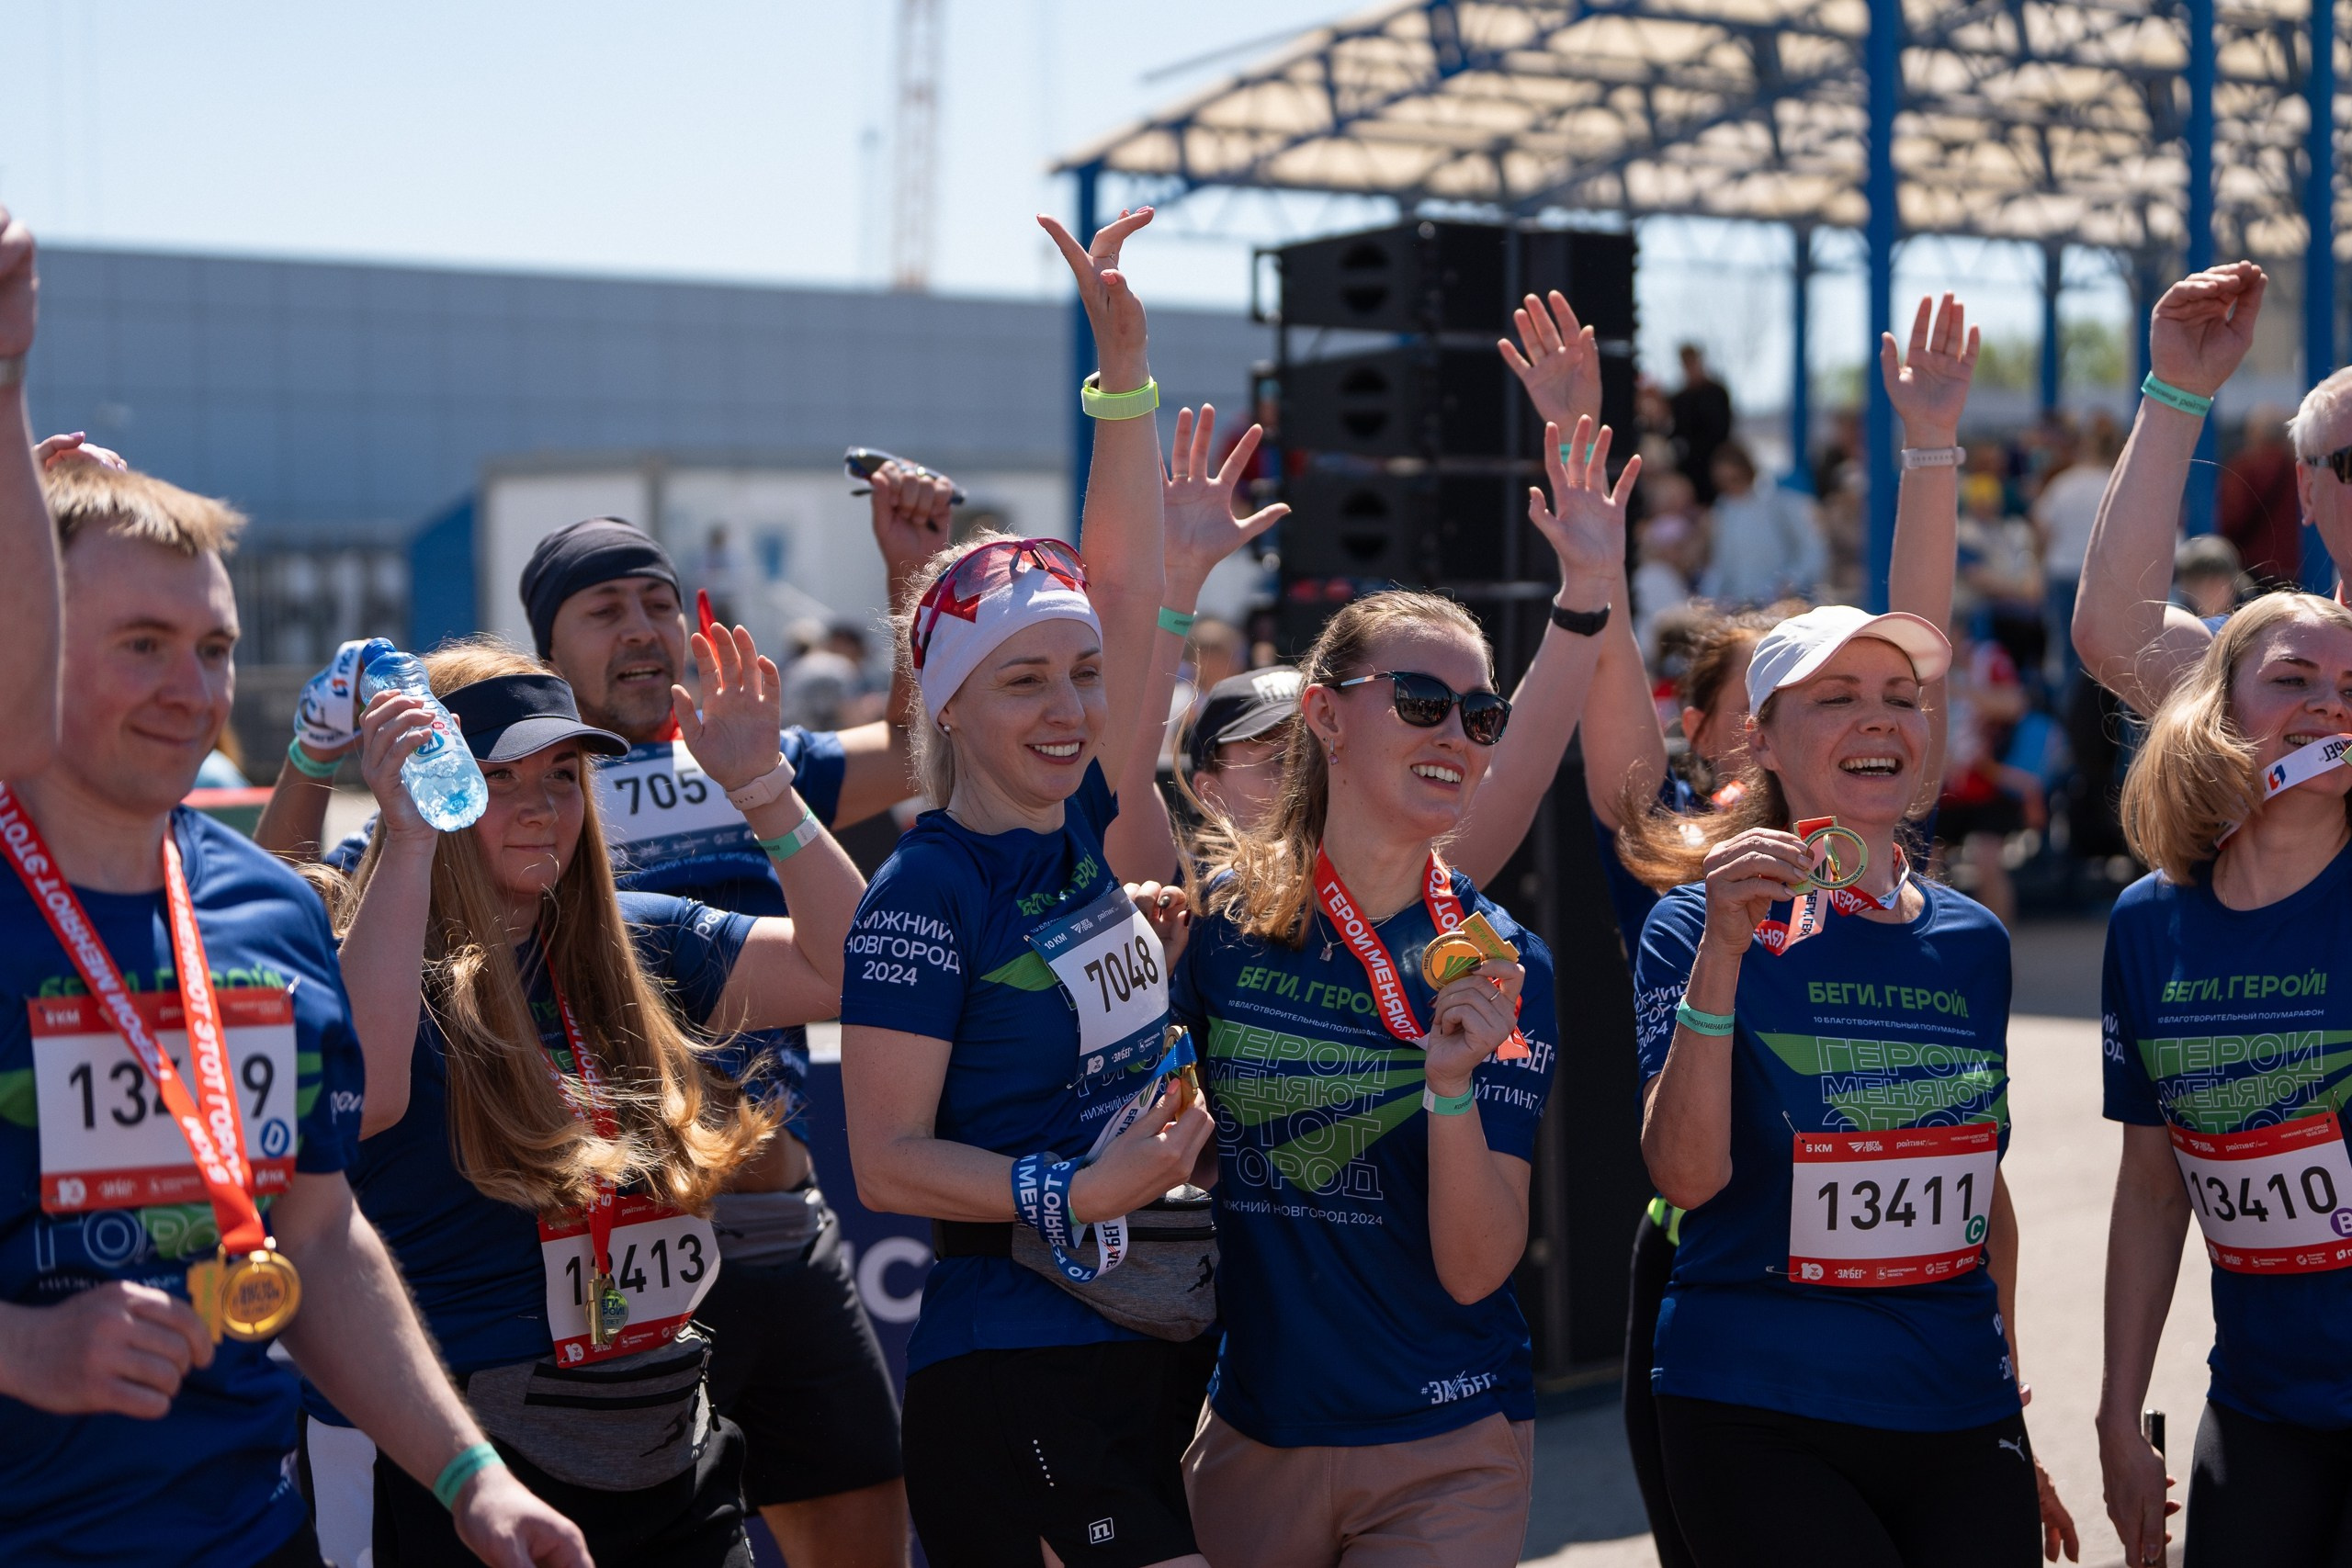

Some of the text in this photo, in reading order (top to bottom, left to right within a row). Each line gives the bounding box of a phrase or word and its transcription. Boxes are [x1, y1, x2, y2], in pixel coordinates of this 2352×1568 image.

[614, 768, 707, 816] 705
[862, 960, 918, 987] 2024
[1082, 935, 1159, 1014] 7048
[1323, 882, 1418, 1037] ГЕРОИ МЕНЯЮТ
[1236, 965, 1379, 1017] БЕГИ, ГЕРО
[1807, 981, 1970, 1018] БЕГИ, ГЕРОЙ!
[2161, 967, 2327, 1003] БЕГИ, ГЕРОЙ!
[1235, 999, 1329, 1029] БЛАГОТВОРИТЕЛЬНЫЙ
[1824, 1017, 1919, 1030] БЛАГОТВОРИТЕЛЬНЫЙ
[1919, 1023, 1975, 1037] ПОЛУМАРАФОН
[2164, 1011, 2257, 1023] БЛАГОТВОРИТЕЛЬНЫЙ
[2257, 1009, 2324, 1020] ПОЛУМАРАФОН
[1210, 1019, 1392, 1084] ГЕРОИ
[1815, 1035, 1993, 1084] ГЕРОИ
[2154, 1030, 2324, 1078] ГЕРОИ
[69, 1053, 275, 1131] 139
[1080, 1095, 1123, 1122] НИЖНИЙ
[1208, 1061, 1385, 1115] МЕНЯЮТ
[1820, 1076, 1995, 1112] МЕНЯЮТ
[2158, 1073, 2324, 1110] МЕНЯЮТ
[263, 1122, 285, 1154] D
[1214, 1097, 1382, 1161] ЭТОТ
[1805, 1144, 1813, 1153] 5
[1216, 1144, 1384, 1201] ГОРОД
[2190, 1166, 2338, 1222] 13410
[1043, 1173, 1068, 1247] ЕНЯЮТ
[1273, 1204, 1348, 1224] НОВГОРОД
[1351, 1213, 1383, 1225] 2024
[1817, 1172, 1974, 1232] 13411
